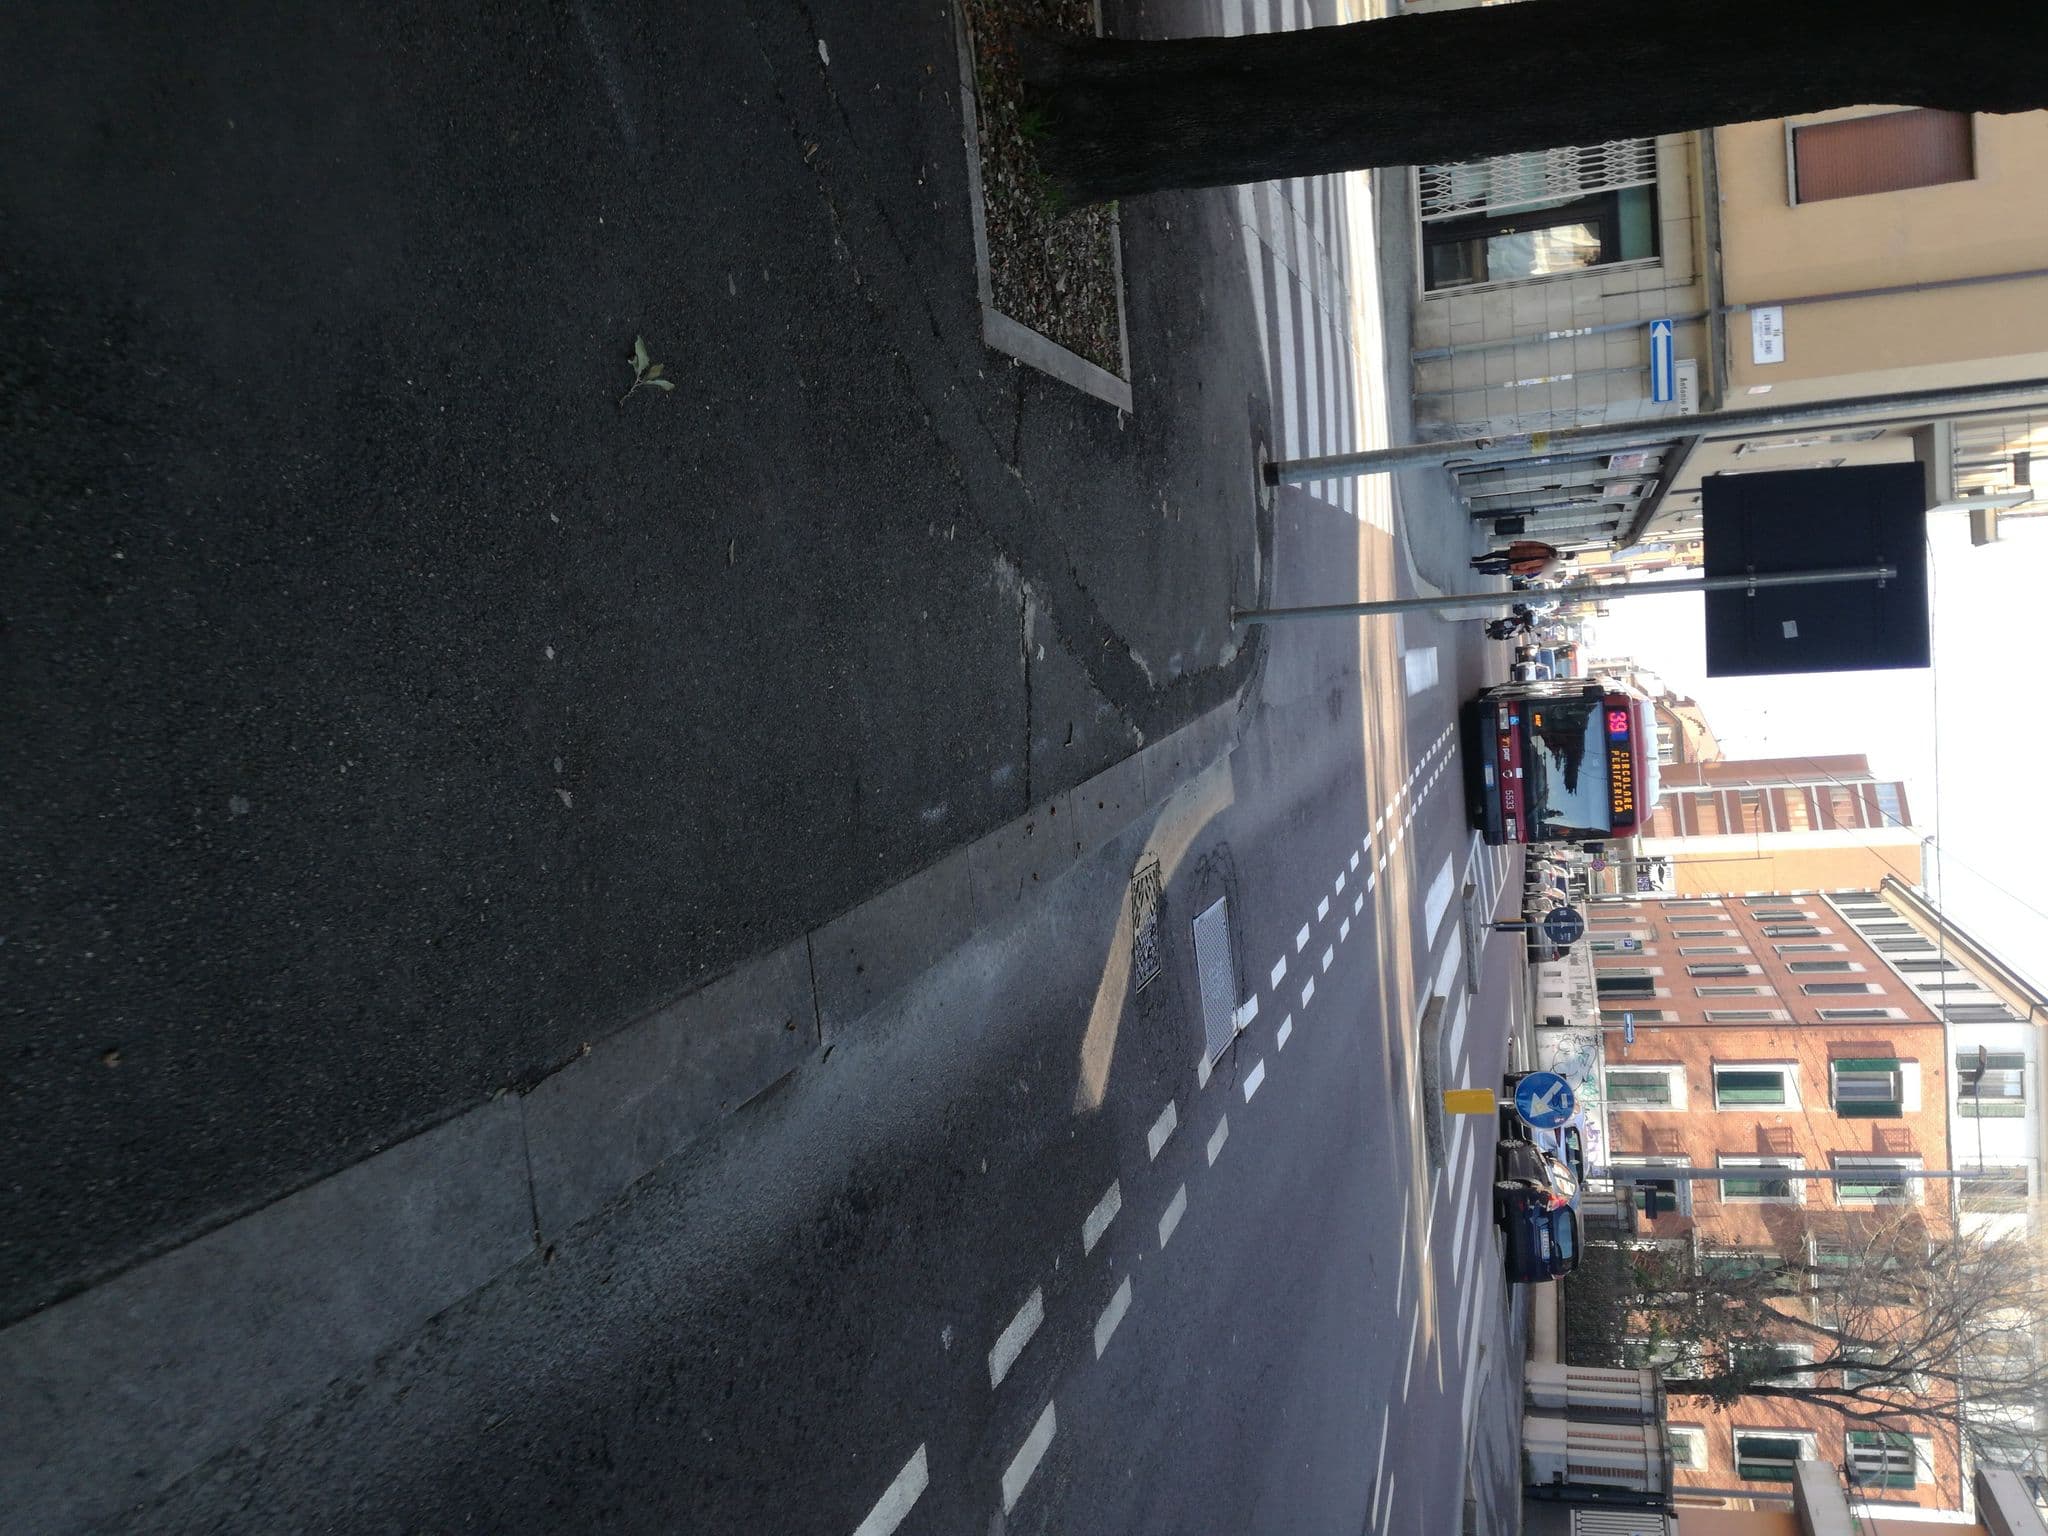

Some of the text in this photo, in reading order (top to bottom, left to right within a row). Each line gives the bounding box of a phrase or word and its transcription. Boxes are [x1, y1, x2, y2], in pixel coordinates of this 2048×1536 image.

[1680, 378, 1688, 405] Antonio
[1608, 712, 1628, 732] 39
[1611, 750, 1623, 812] PERIFERICA
[1621, 752, 1632, 810] CIRCOLARE
[1505, 790, 1514, 809] 5533
